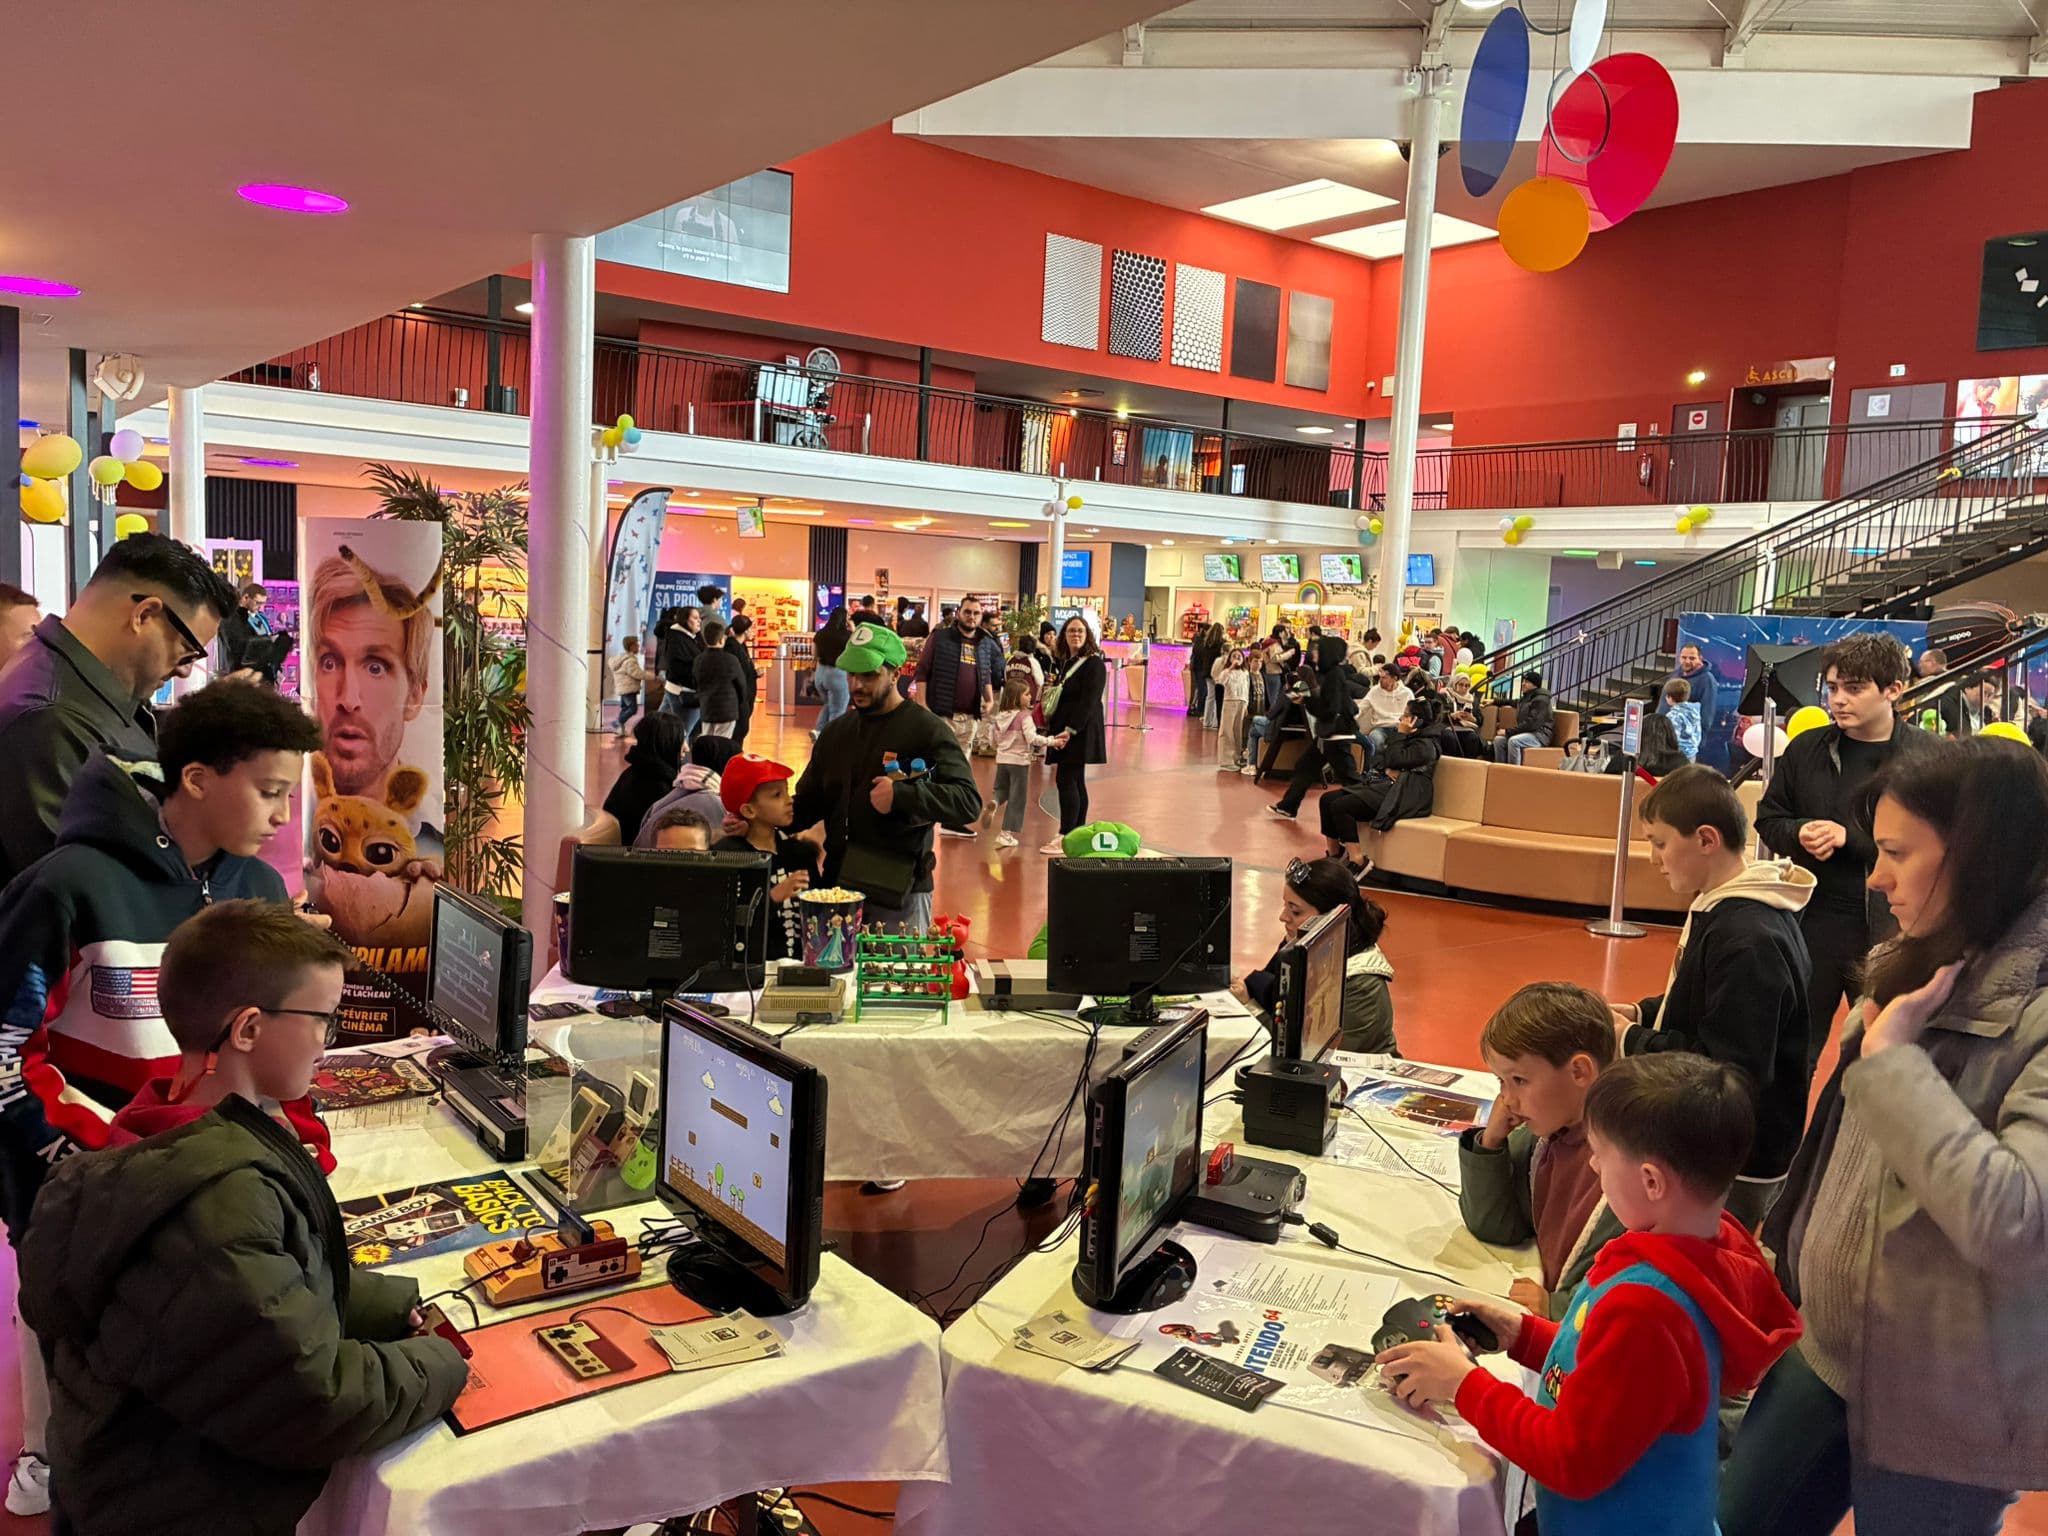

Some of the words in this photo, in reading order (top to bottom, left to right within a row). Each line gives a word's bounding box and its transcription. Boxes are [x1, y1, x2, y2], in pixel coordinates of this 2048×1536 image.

[655, 592, 671, 608] SA
[1099, 833, 1113, 849] L
[353, 990, 391, 999] LACHEAU
[343, 1008, 388, 1021] FÉVRIER
[341, 1020, 384, 1032] CINÉMA
[451, 1184, 520, 1234] BASICS
[482, 1179, 530, 1211] BACK
[516, 1208, 546, 1229] TO
[346, 1206, 400, 1232] GAME
[398, 1197, 430, 1215] BOY
[1262, 1309, 1283, 1321] 64
[1243, 1321, 1286, 1373] NTENDO
